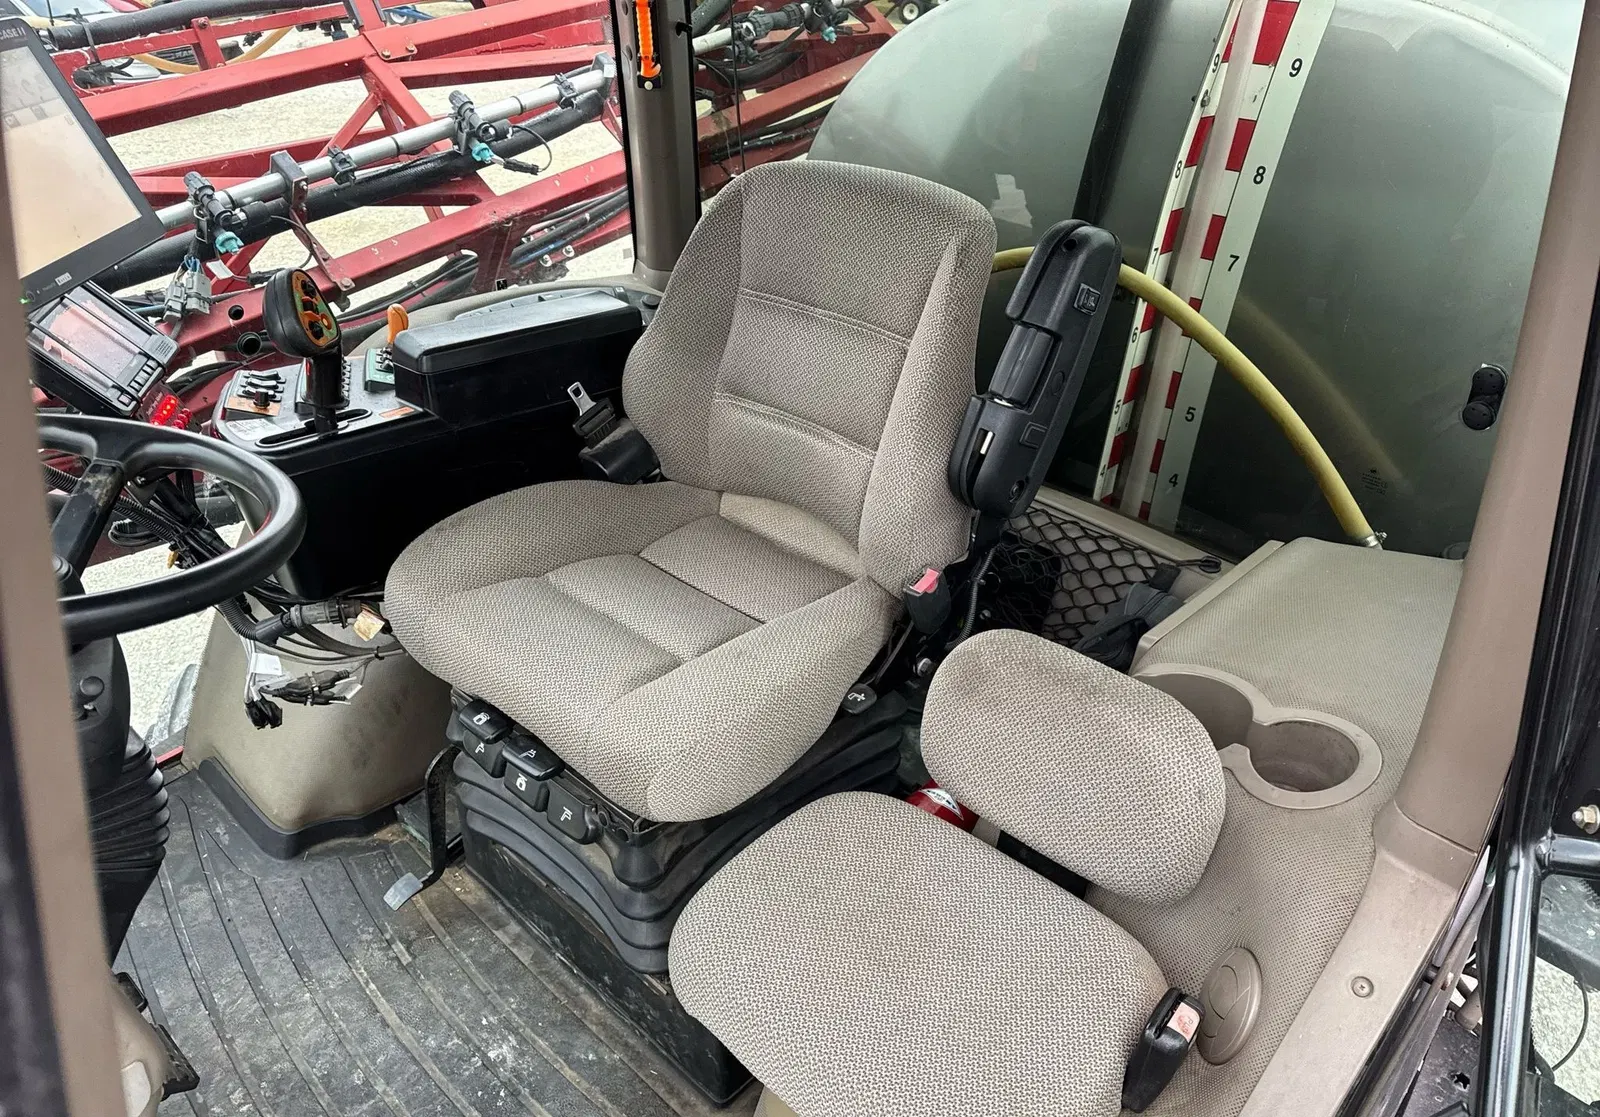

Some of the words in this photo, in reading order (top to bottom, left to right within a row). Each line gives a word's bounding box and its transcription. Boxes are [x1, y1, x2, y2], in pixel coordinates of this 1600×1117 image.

[1212, 53, 1220, 74] 9
[1288, 57, 1303, 78] 9
[1174, 160, 1183, 179] 8
[1252, 165, 1267, 185] 8
[1151, 247, 1160, 265] 7
[1227, 253, 1240, 272] 7
[1131, 326, 1139, 344] 6
[1114, 398, 1122, 415] 5
[1184, 405, 1197, 423] 5
[1168, 473, 1179, 488] 4
